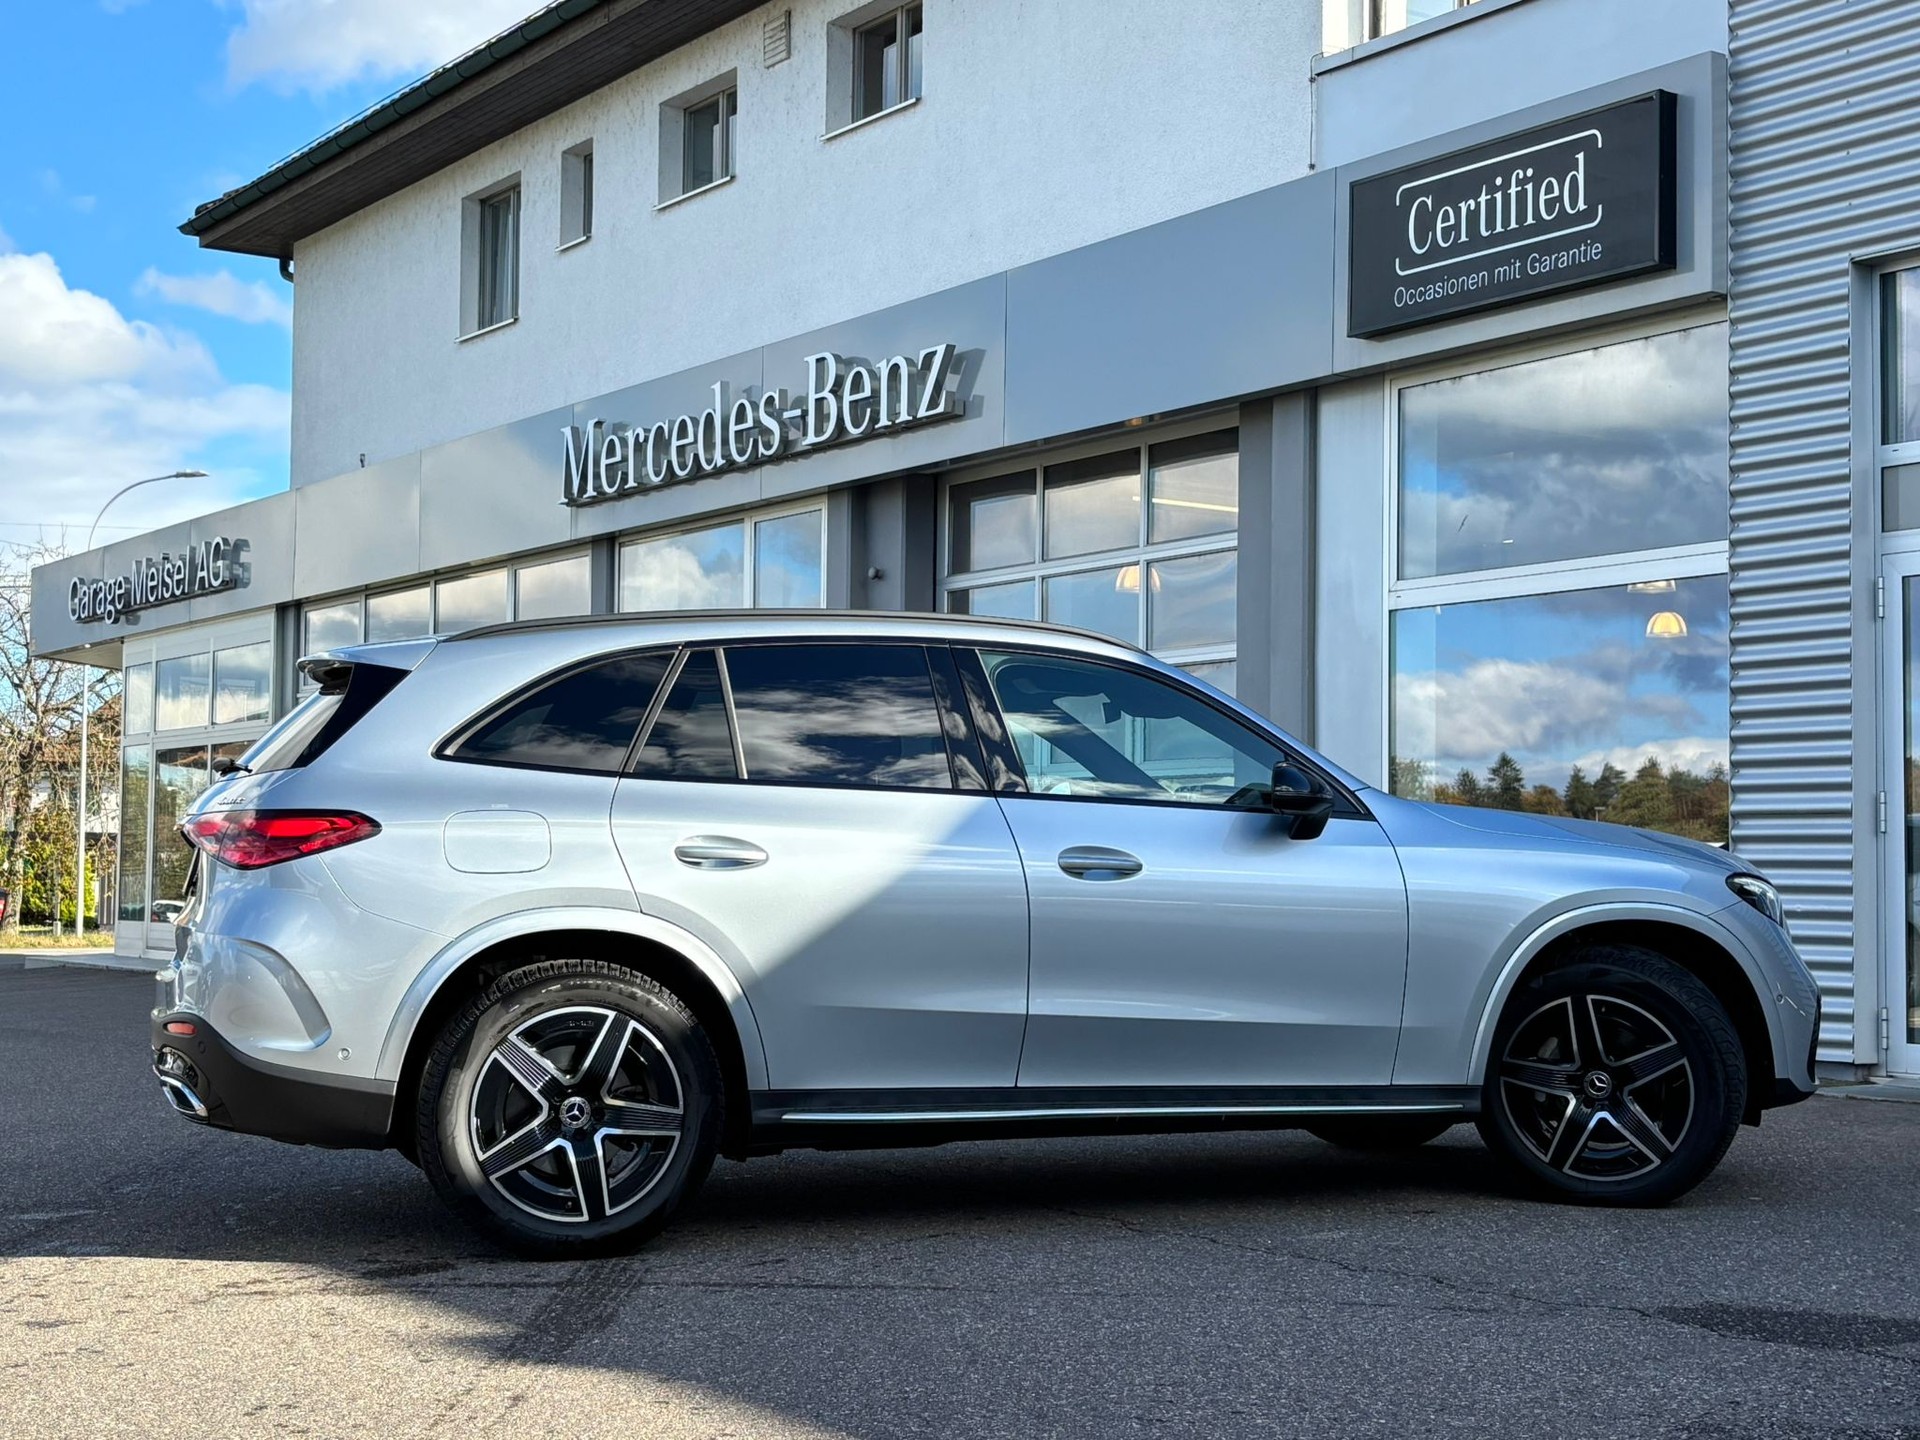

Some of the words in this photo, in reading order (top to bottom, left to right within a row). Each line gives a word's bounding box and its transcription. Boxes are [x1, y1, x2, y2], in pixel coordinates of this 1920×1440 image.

[1407, 150, 1588, 255] Certified
[1393, 271, 1489, 308] Occasionen
[1493, 257, 1522, 285] mit
[1527, 239, 1602, 276] Garantie
[557, 342, 959, 506] Mercedes-Benz
[67, 575, 126, 625] Garage
[130, 543, 192, 606] Meisel
[194, 535, 225, 591] AG
